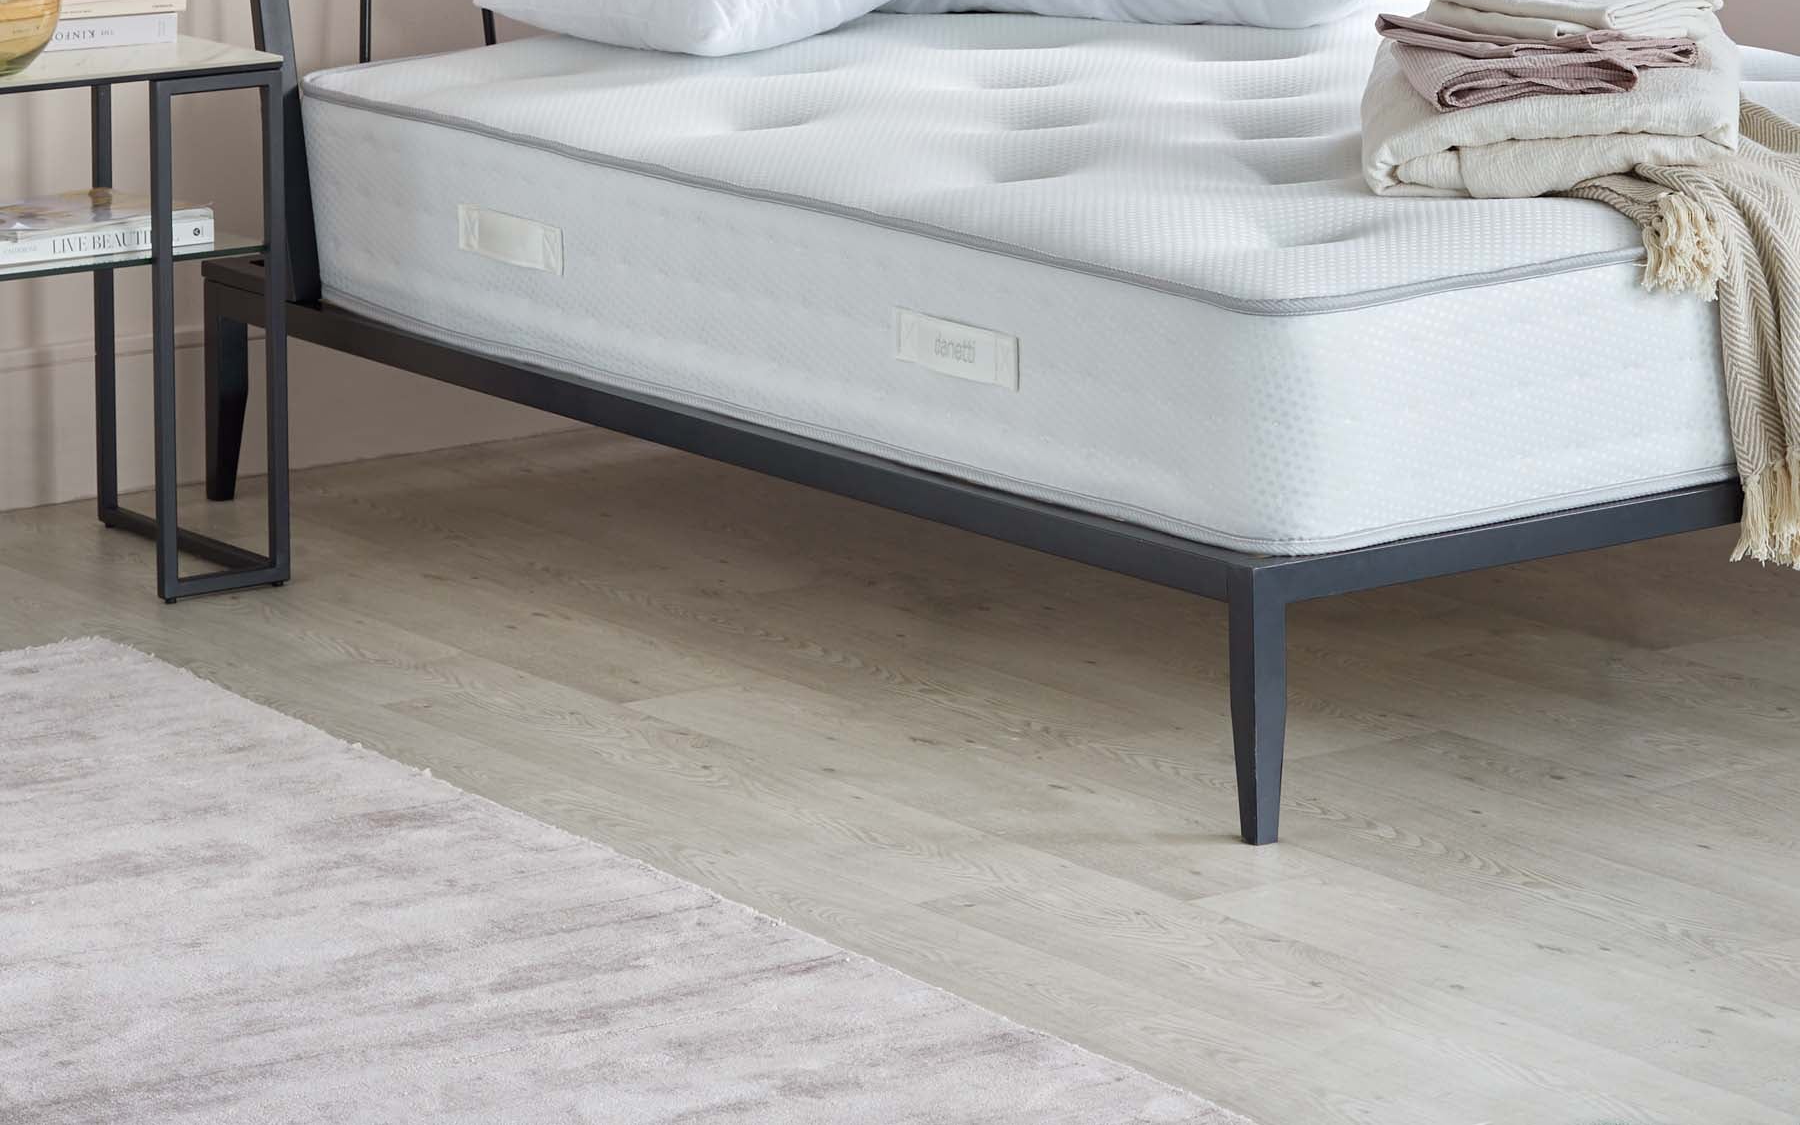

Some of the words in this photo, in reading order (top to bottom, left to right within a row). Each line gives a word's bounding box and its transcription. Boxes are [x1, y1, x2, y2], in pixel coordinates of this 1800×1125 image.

[54, 29, 96, 42] KINFO
[51, 236, 89, 255] LIVE
[92, 229, 151, 251] BEAUTI
[934, 330, 976, 364] danetti
